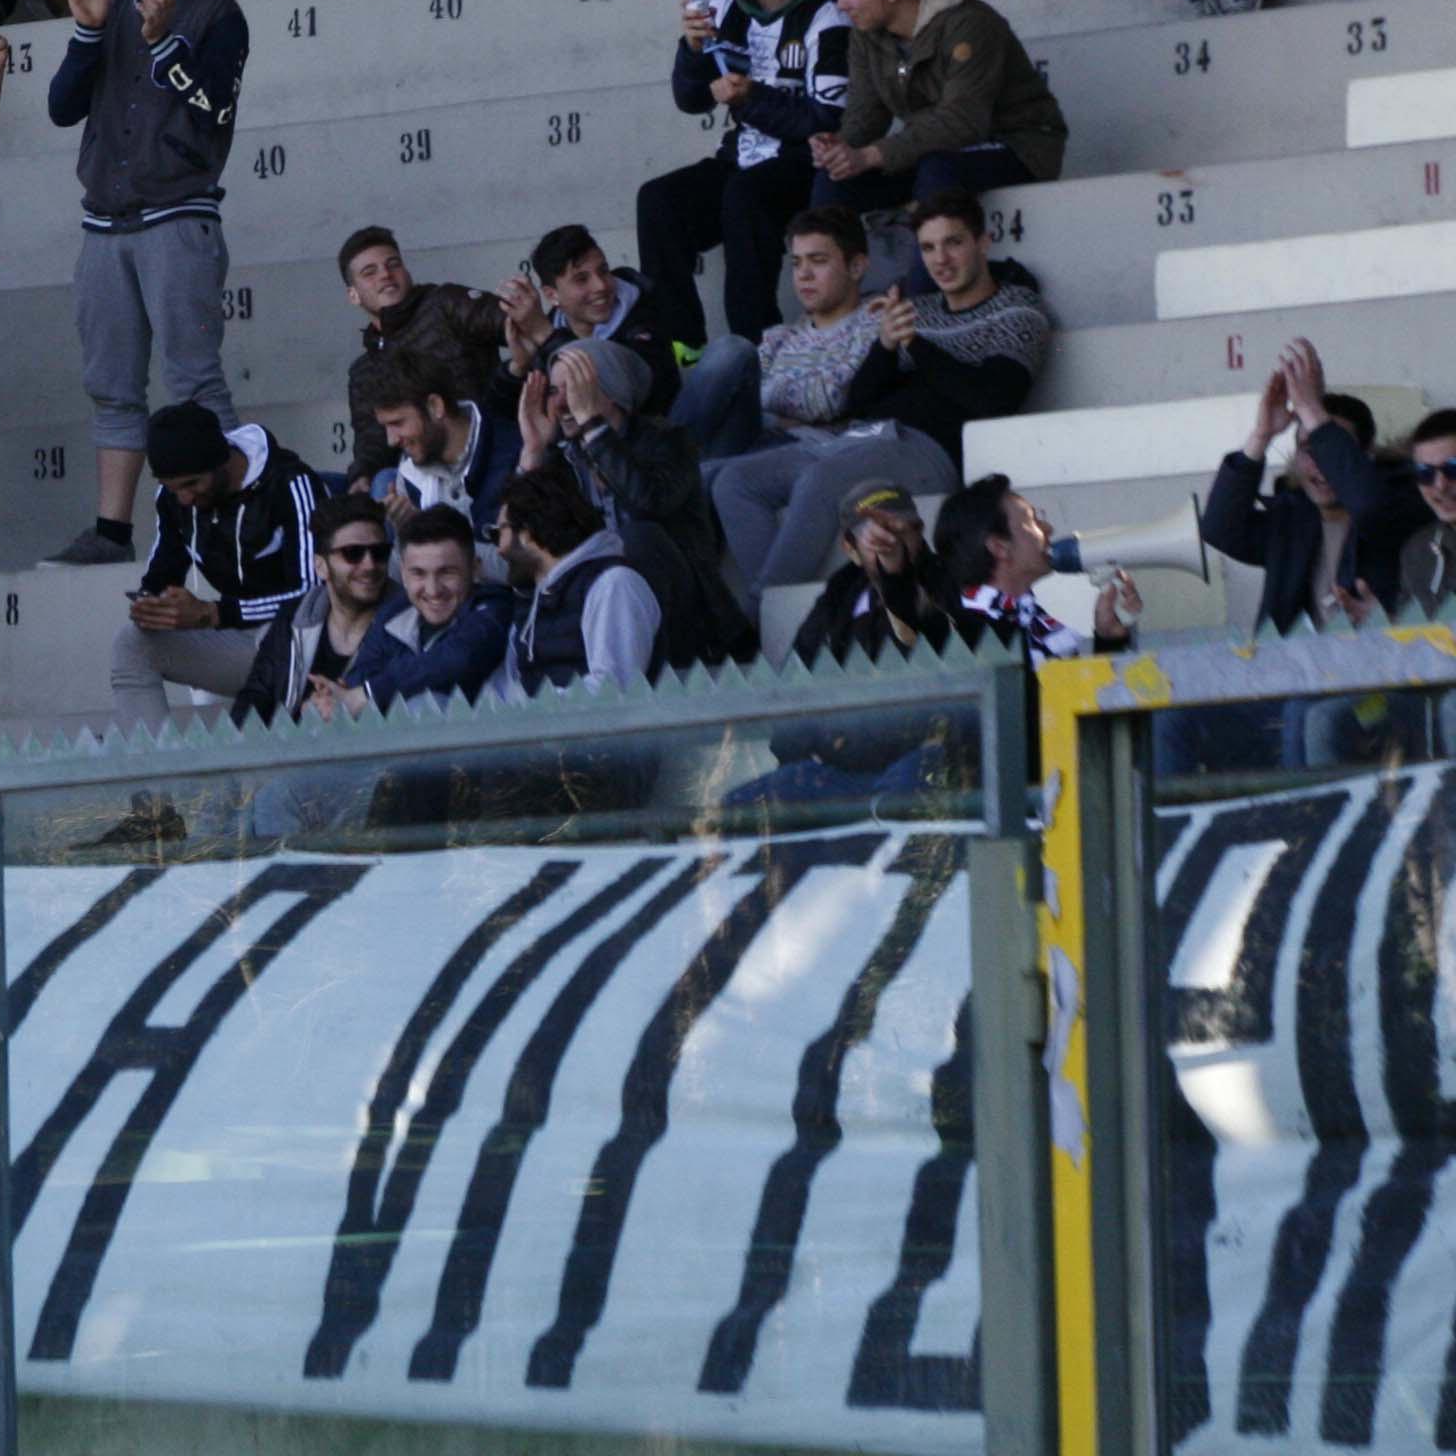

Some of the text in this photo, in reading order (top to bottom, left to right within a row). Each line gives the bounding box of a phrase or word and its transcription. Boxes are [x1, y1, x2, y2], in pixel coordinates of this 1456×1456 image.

[288, 6, 317, 37] 41
[1347, 17, 1387, 55] 33
[1175, 40, 1210, 75] 34
[400, 128, 431, 164] 39
[548, 112, 581, 146] 38
[254, 145, 285, 179] 40
[1157, 189, 1194, 226] 33
[991, 209, 1024, 243] 34
[221, 287, 252, 320] 39
[333, 422, 347, 454] 3
[33, 446, 65, 480] 39
